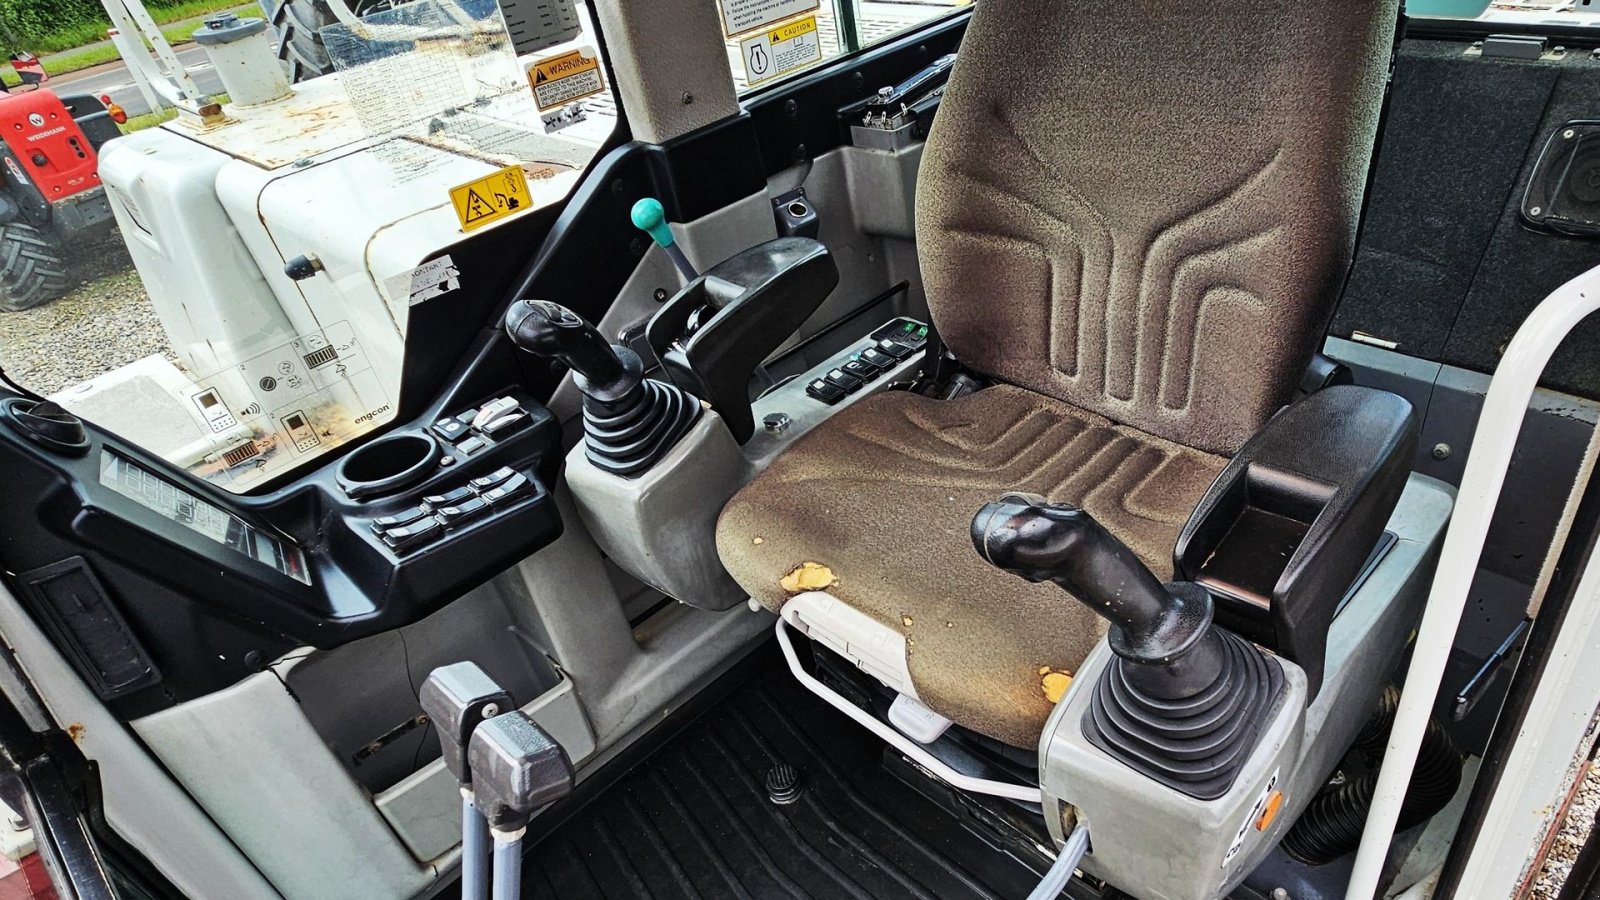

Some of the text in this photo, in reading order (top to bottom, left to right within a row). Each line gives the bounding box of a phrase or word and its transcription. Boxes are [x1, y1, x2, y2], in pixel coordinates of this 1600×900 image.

[784, 23, 811, 36] CAUTION
[549, 59, 590, 75] WARNING
[27, 126, 66, 142] WEIDEMANN
[354, 404, 390, 425] engcon
